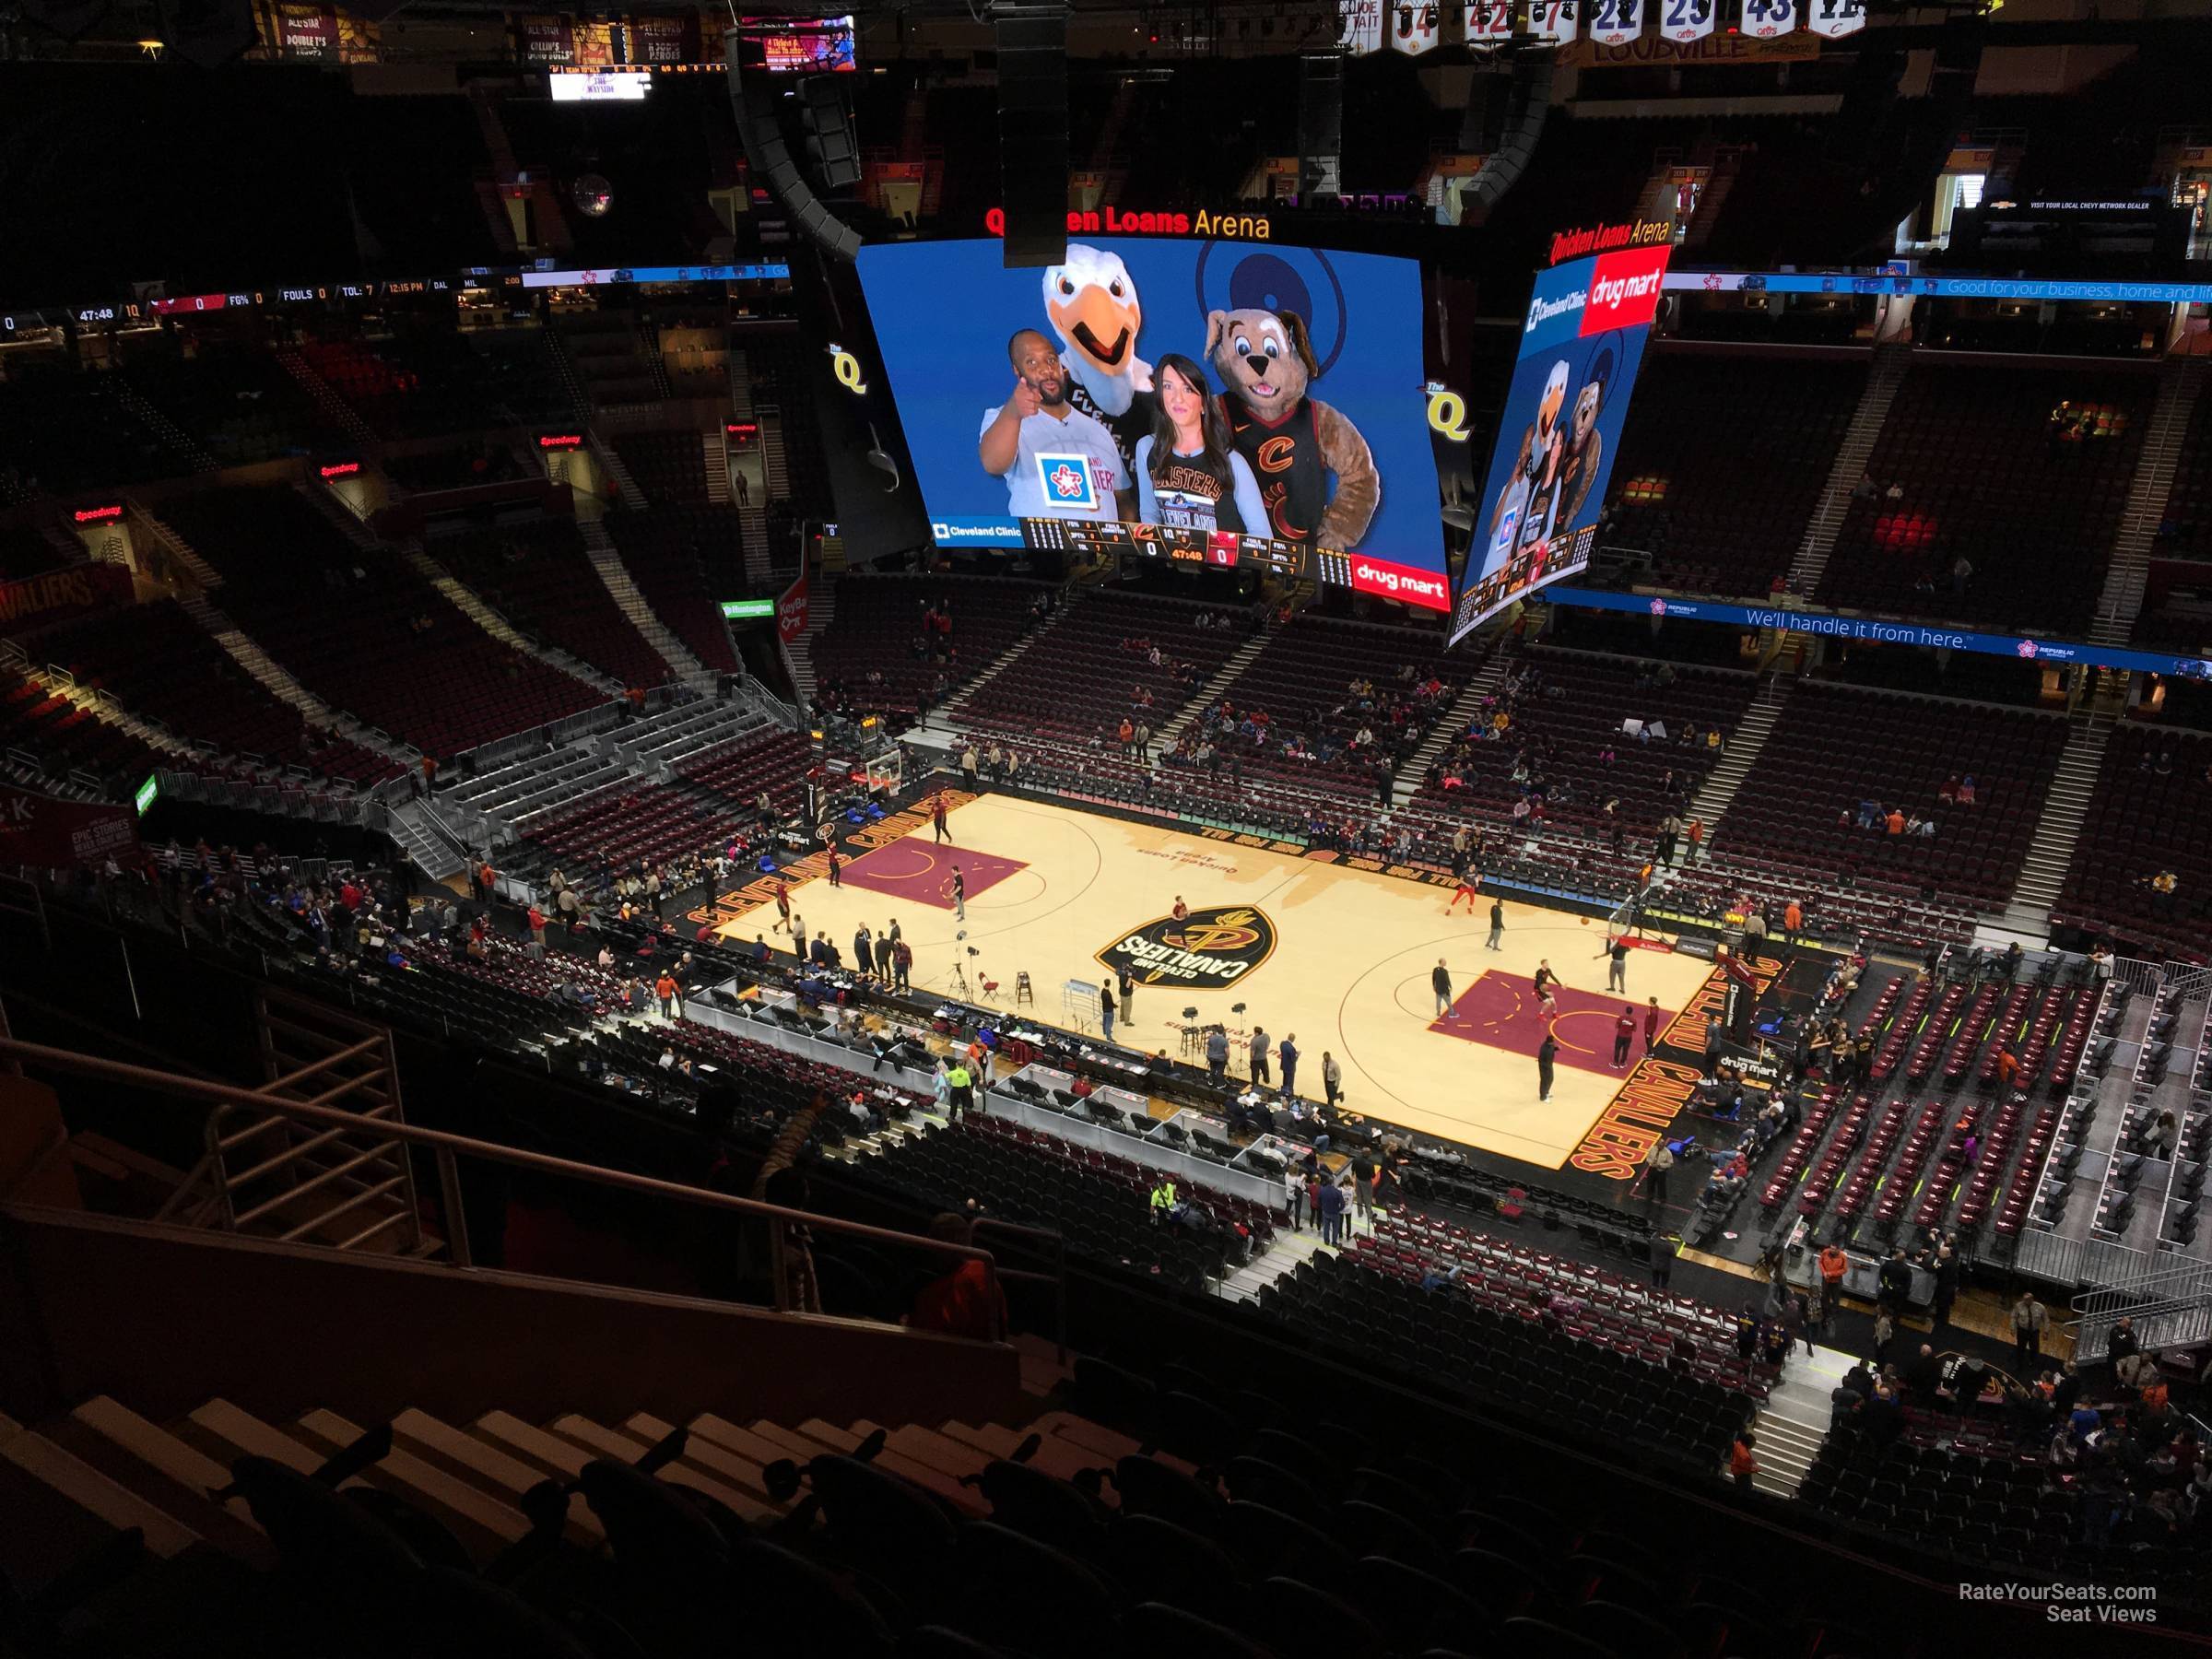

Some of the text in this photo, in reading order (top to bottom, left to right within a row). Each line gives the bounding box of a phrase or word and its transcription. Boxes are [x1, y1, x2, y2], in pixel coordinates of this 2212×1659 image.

[287, 34, 313, 46] DOUBLE
[1107, 206, 1189, 233] Loans
[1194, 208, 1270, 239] Arena
[1550, 218, 1670, 266] Quicken Loans Arena
[390, 282, 423, 293] 12:15 PM
[434, 281, 448, 290] DAL
[464, 279, 477, 288] MIL
[1592, 267, 1660, 310] drug mart
[1947, 279, 1986, 295] Good
[1989, 279, 2013, 295] for
[2012, 282, 2044, 298] your
[2048, 279, 2113, 299] business,
[2118, 281, 2162, 299] home
[2165, 283, 2194, 300] and
[283, 288, 326, 302] FOULS 0
[342, 285, 373, 297] TOL: 7
[195, 298, 204, 311] 0
[229, 293, 263, 306] FG% 0
[1539, 289, 1587, 321] Cleveland Clinic
[79, 308, 114, 322] 47:48
[5, 316, 15, 330] 0
[834, 352, 867, 394] Q
[1428, 382, 1445, 392] The
[1427, 392, 1470, 441] Q
[540, 434, 582, 447] Speedway
[321, 463, 359, 477] Speedway
[75, 505, 122, 522] Speedway
[950, 526, 1021, 537] Cleveland Clinic
[1146, 542, 1157, 556] 0
[1273, 542, 1287, 550] FG%
[1171, 548, 1203, 561] 47:48
[1217, 549, 1227, 564] 0
[1272, 553, 1288, 562] 3PT%
[1271, 565, 1283, 573] TOL
[1357, 564, 1398, 590] drug
[1400, 578, 1444, 599] mart
[731, 605, 771, 615] Huntington
[1667, 605, 1697, 613] REPUBLIC
[1746, 609, 1967, 650] We'll handle it from here.
[2039, 647, 2075, 656] REPUBLIC
[72, 830, 92, 844] EPIC
[93, 818, 130, 838] STORIES
[778, 831, 794, 842] drug
[794, 835, 810, 846] mart
[1182, 857, 1239, 874] Quicken
[1115, 935, 1250, 979] CAVALIERS
[1132, 958, 1199, 979] CLEVELAND
[1720, 1055, 1778, 1078] drug mart
[1570, 1058, 1704, 1181] CAVALIERS
